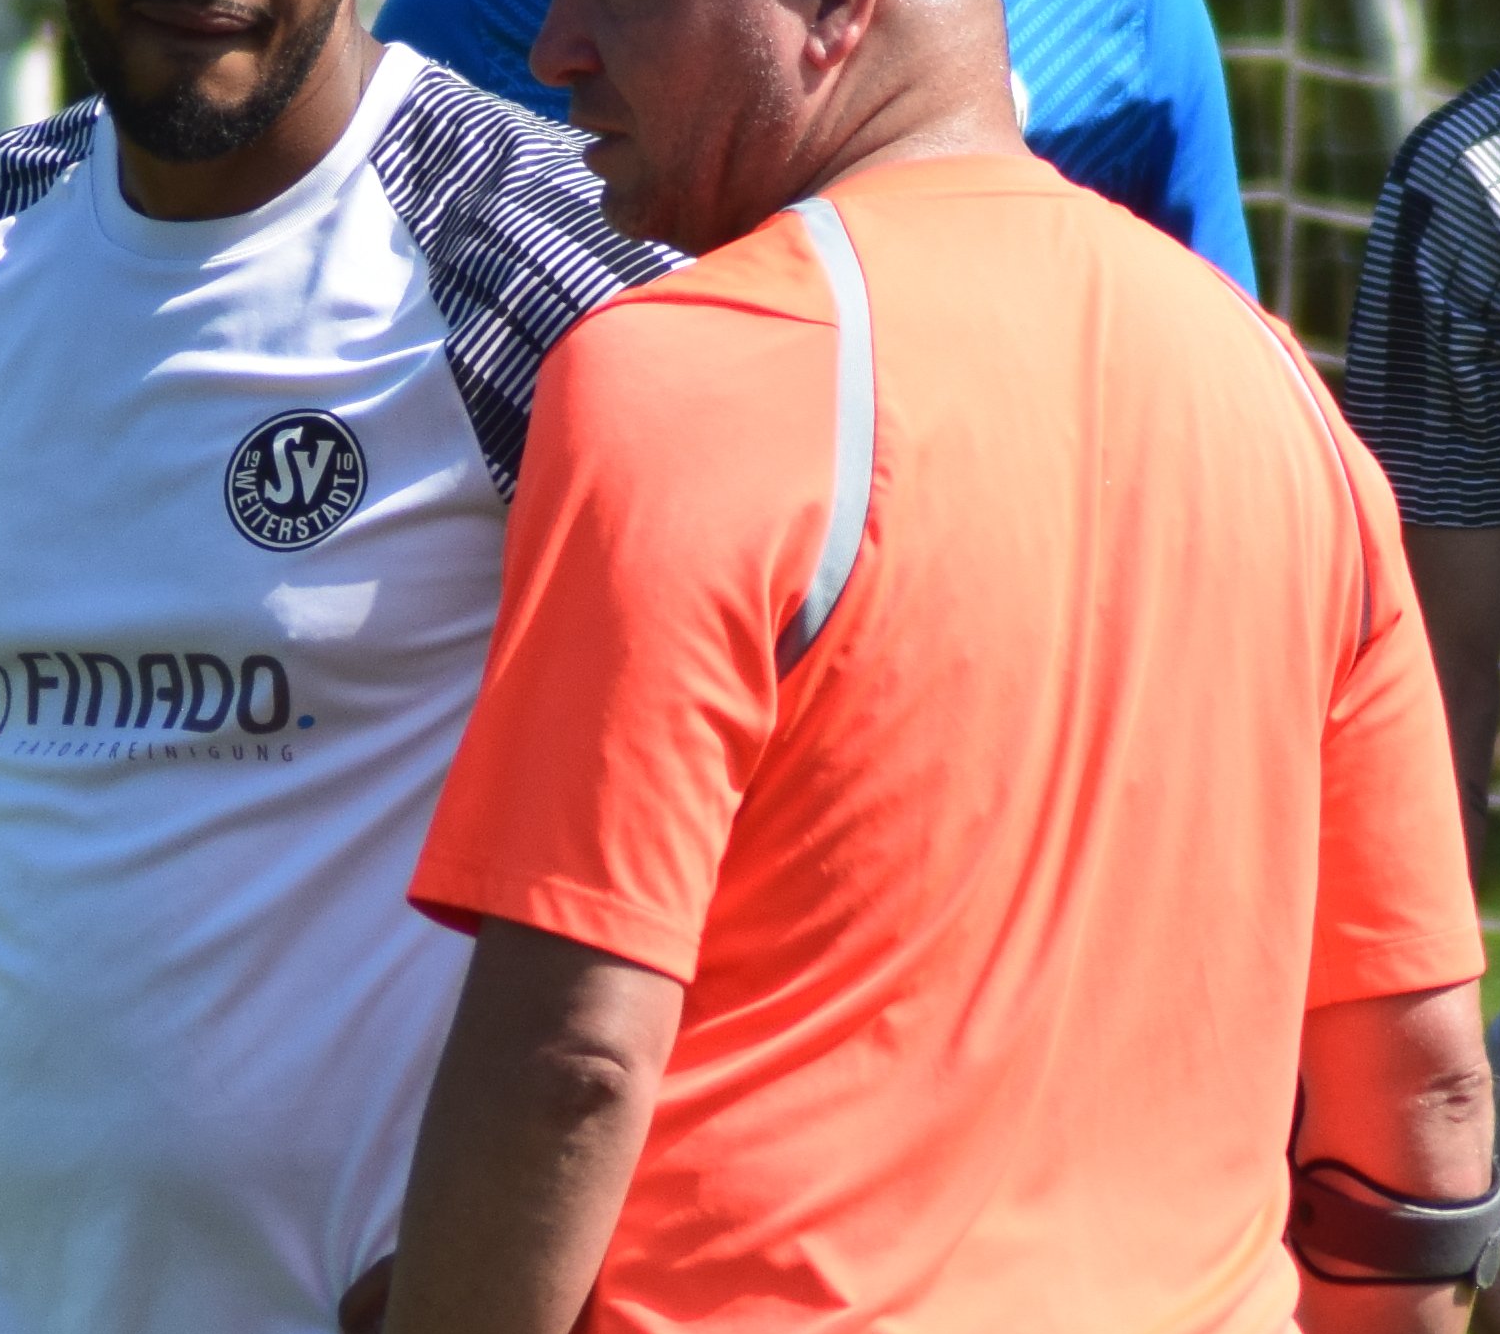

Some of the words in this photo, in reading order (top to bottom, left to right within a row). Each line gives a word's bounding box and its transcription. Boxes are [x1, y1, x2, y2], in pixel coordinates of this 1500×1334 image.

[243, 450, 261, 468] 19
[336, 452, 353, 471] 10
[264, 425, 336, 504] SV
[234, 469, 356, 541] WEITERSTADT
